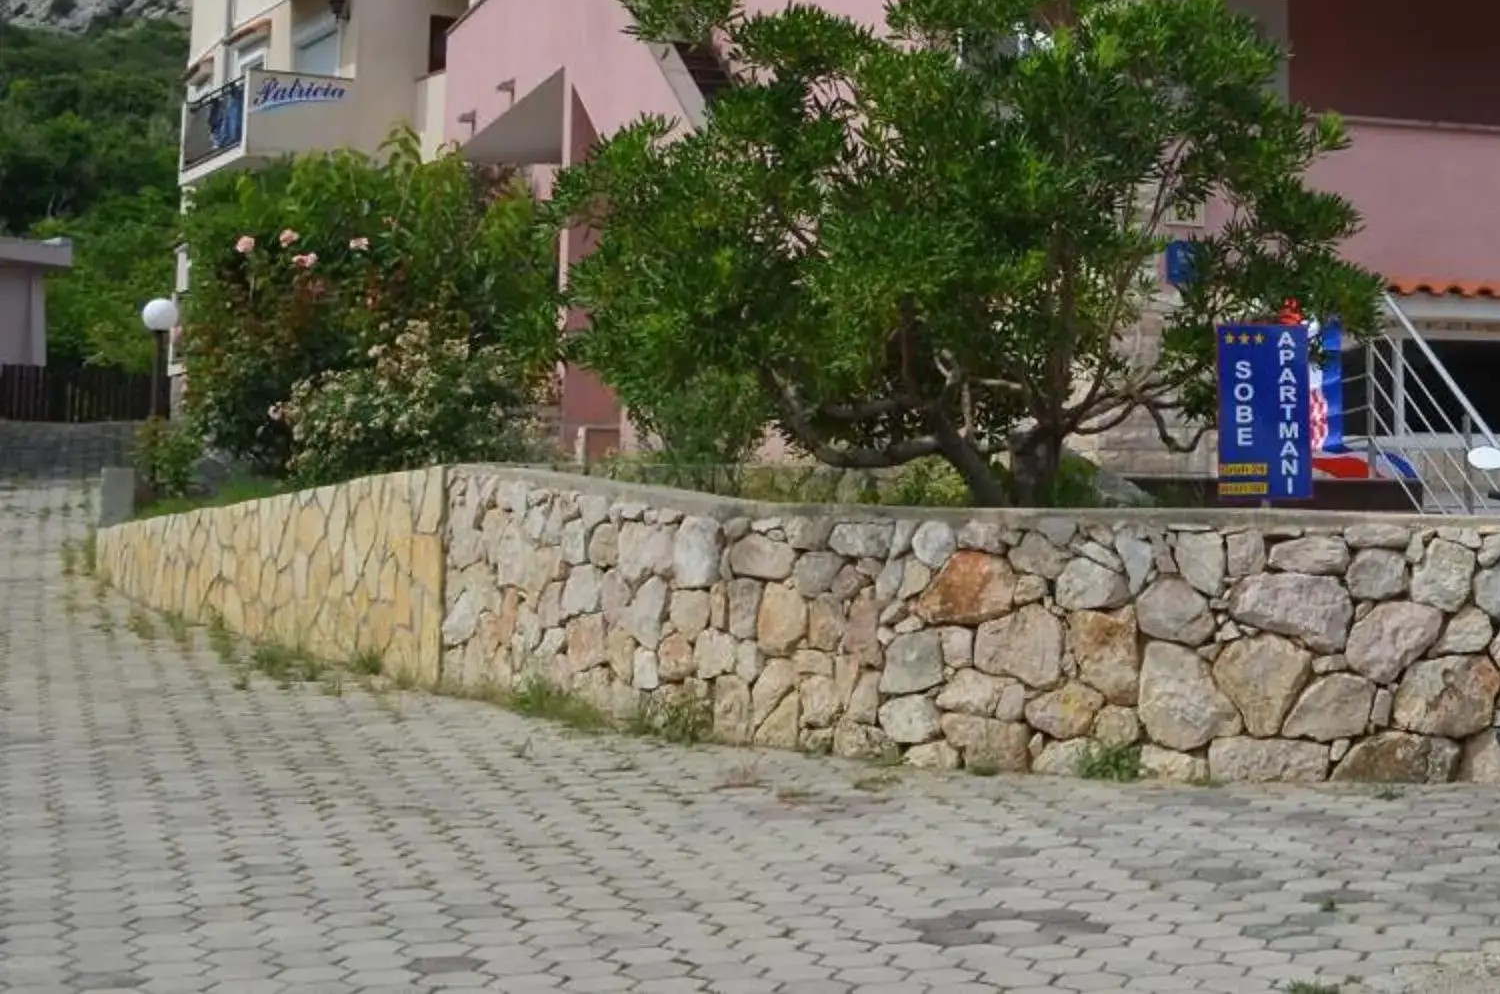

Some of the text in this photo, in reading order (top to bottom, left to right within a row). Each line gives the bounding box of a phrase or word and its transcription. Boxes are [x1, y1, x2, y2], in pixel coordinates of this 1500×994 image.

[253, 78, 345, 106] Patricia
[1234, 360, 1254, 447] SOBE
[1278, 331, 1299, 495] APARTMANI
